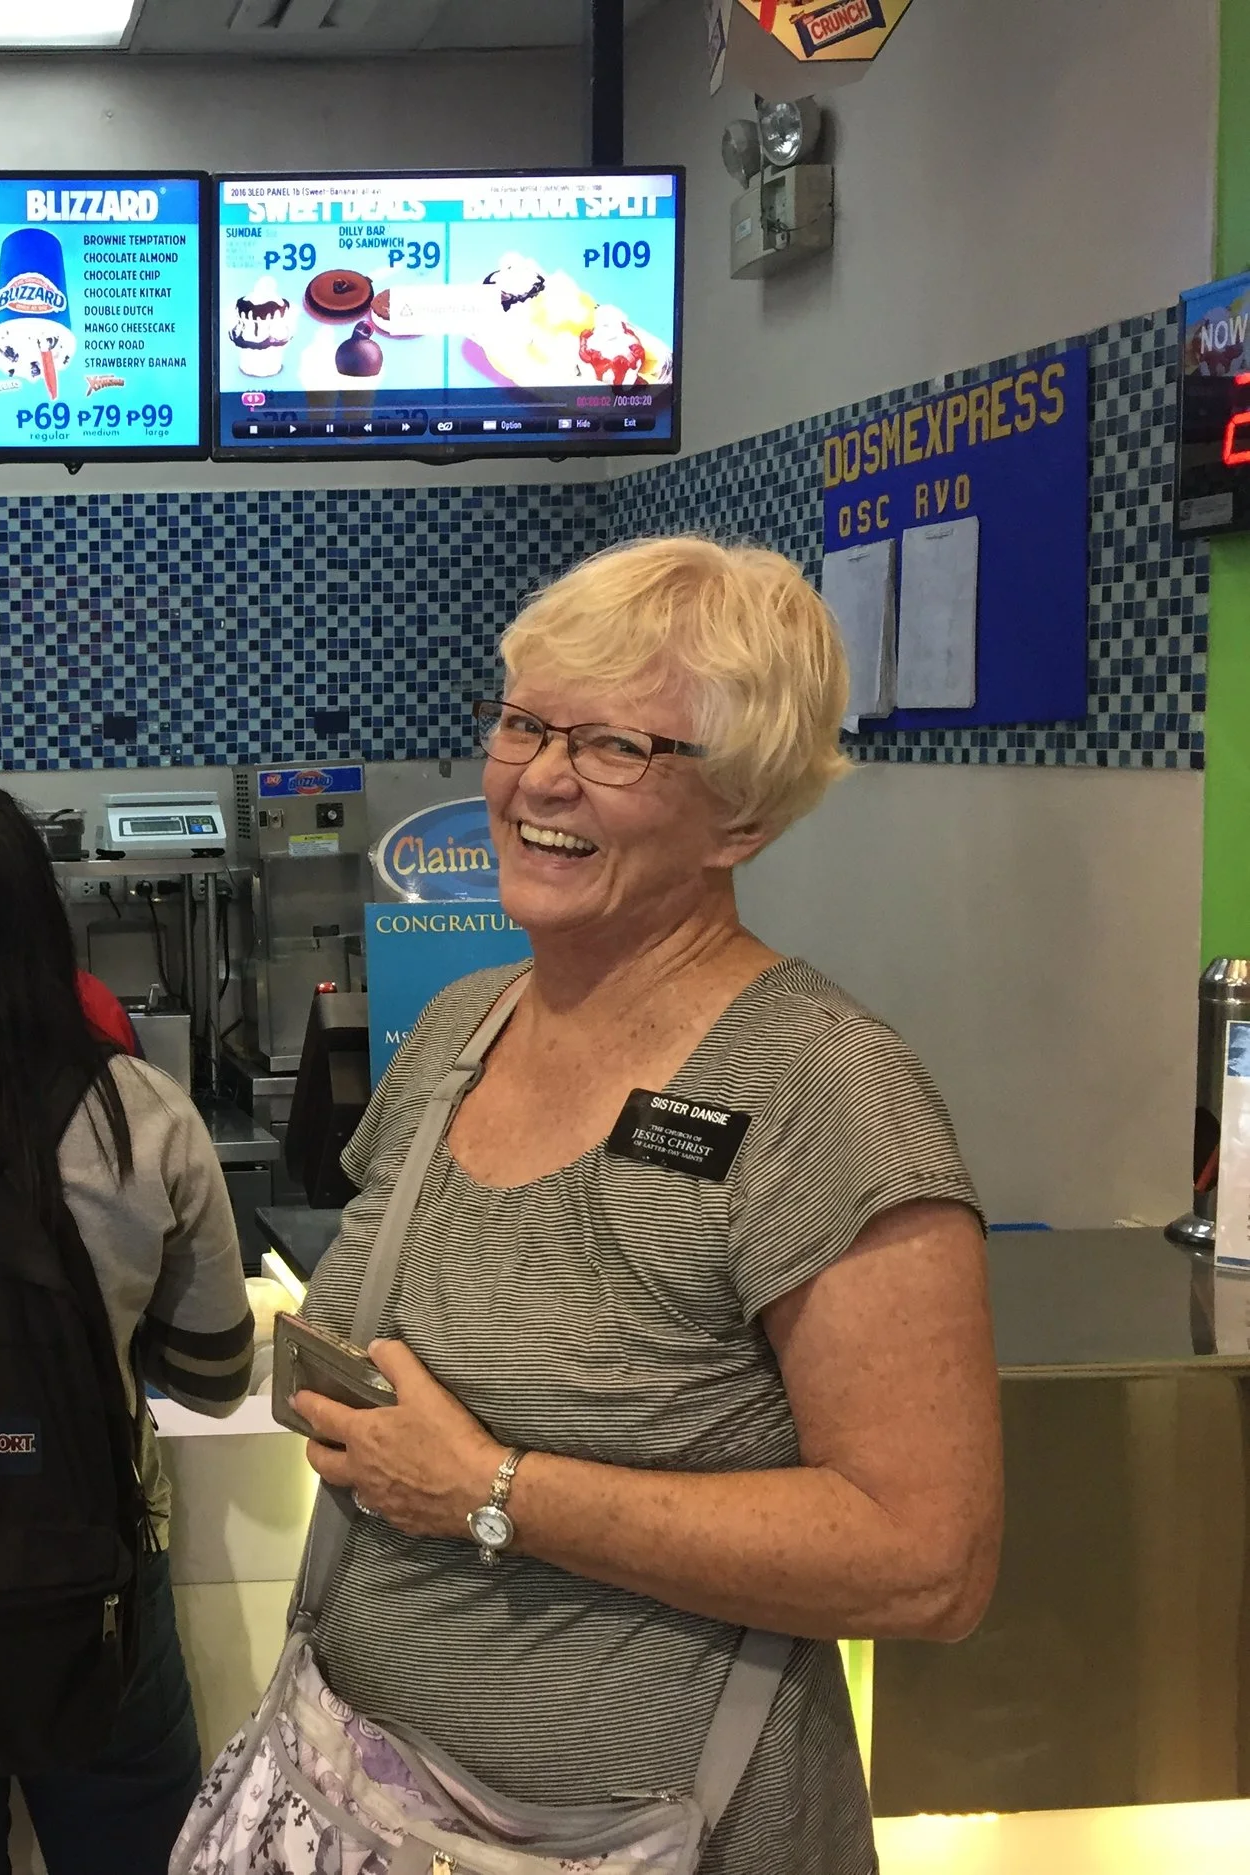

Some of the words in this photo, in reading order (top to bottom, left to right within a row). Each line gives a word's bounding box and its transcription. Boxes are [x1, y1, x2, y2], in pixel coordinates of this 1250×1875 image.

[811, 1, 868, 40] CRUNCH
[267, 188, 290, 197] PANEL
[26, 190, 158, 221] BLIZZARD
[226, 227, 262, 238] SUNDAE
[339, 226, 363, 236] DILLY
[366, 226, 385, 236] BAR
[84, 235, 126, 246] BROWNIE
[129, 234, 186, 245] TEMPTATION
[356, 237, 404, 248] SANDWICH
[84, 252, 137, 263] CHOCOLATE
[139, 252, 178, 263] ALMOND
[84, 270, 137, 281] CHOCOLATE
[139, 270, 161, 281] CHIP
[84, 288, 137, 299] CHOCOLATE
[139, 287, 172, 298] KITKAT
[84, 306, 121, 316] DOUBLE
[123, 306, 154, 316] DUTCH
[84, 323, 119, 333] MANGO
[121, 323, 176, 333] CHEESECAKE
[1200, 313, 1250, 354] NOW
[84, 340, 115, 350] ROCKY
[118, 340, 145, 350] ROAD
[84, 358, 146, 368] STRAWBERRY
[148, 357, 187, 368] BANANA
[501, 420, 522, 430] Option
[576, 419, 591, 429] Hide
[624, 418, 636, 427] Exit
[824, 362, 1066, 488] DOSMEXPRESS
[30, 431, 70, 442] regular
[83, 428, 120, 436] medium
[145, 427, 169, 438] large
[393, 836, 490, 876] Claim
[651, 1096, 688, 1115] SISTER
[690, 1106, 731, 1126] DANSIE
[651, 1124, 664, 1133] THE
[665, 1128, 693, 1141] CHURCH
[631, 1128, 666, 1145] JESUS
[668, 1137, 714, 1157] CHRIST
